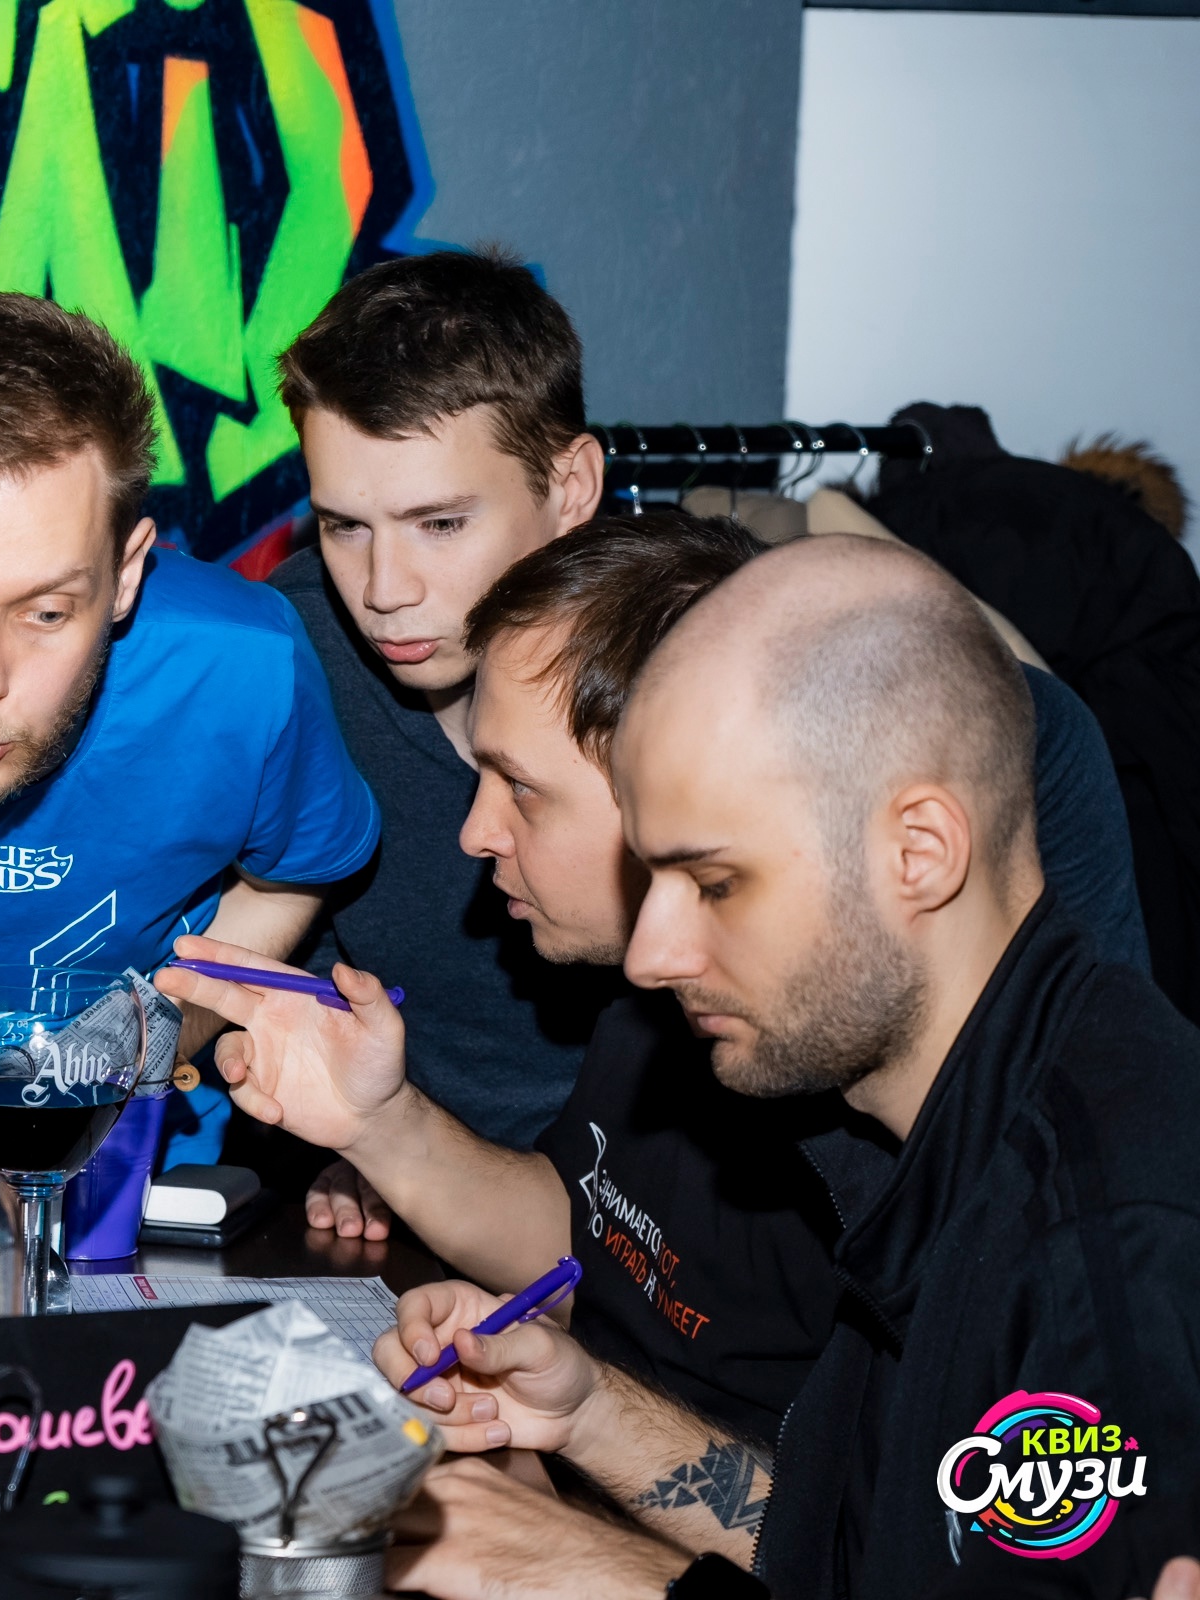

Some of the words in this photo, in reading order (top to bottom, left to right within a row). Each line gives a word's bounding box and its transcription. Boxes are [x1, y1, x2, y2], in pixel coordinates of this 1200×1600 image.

[21, 1035, 111, 1107] Abbé
[605, 1225, 647, 1284] ИГРАТЬ
[657, 1283, 710, 1339] УМЕЕТ
